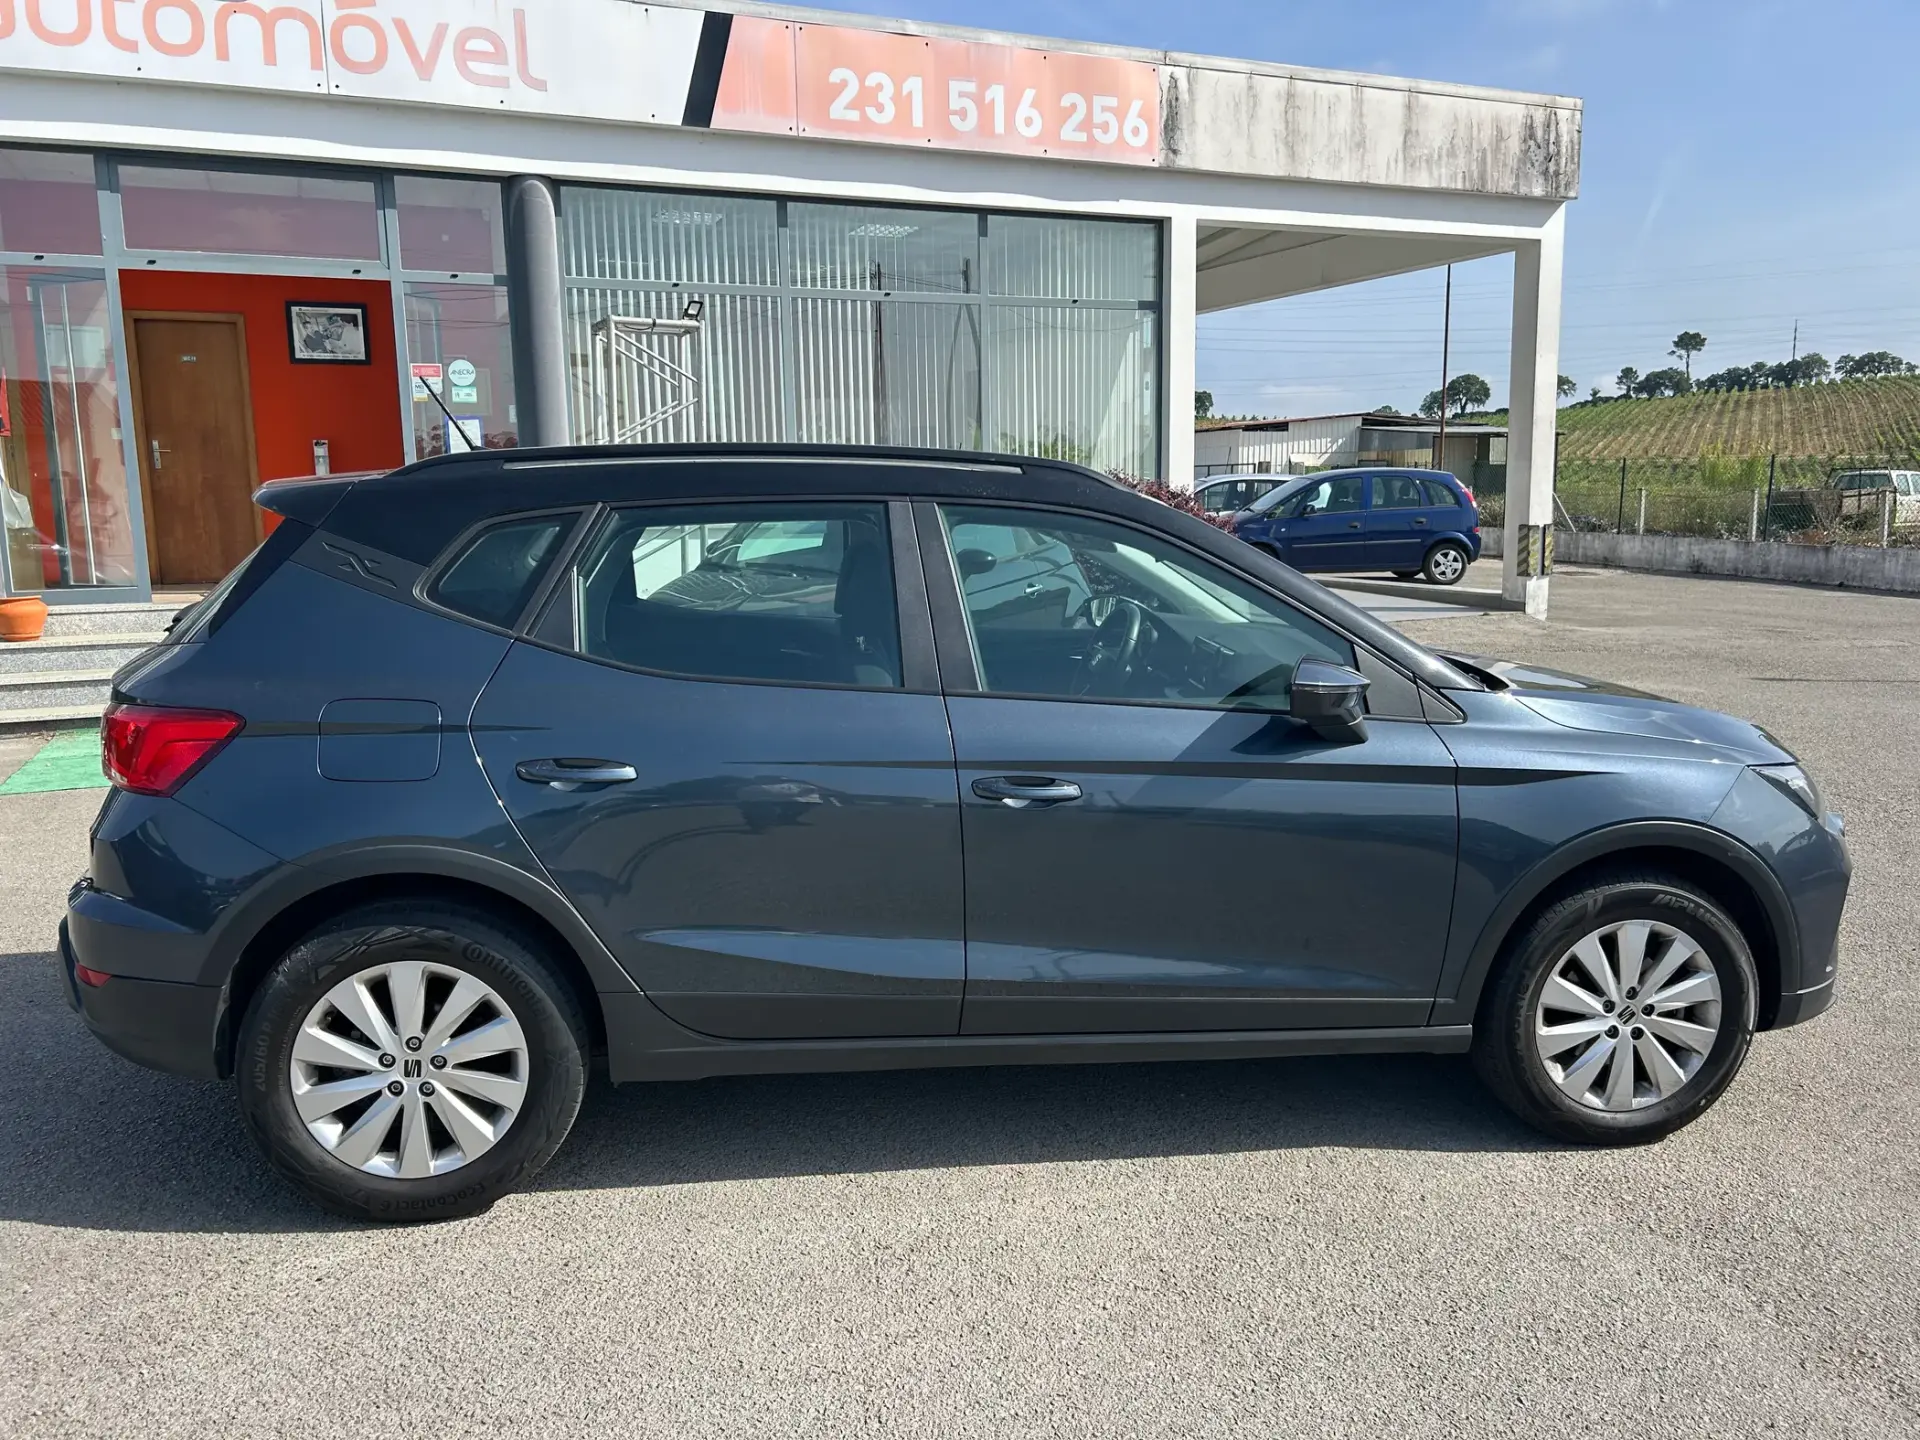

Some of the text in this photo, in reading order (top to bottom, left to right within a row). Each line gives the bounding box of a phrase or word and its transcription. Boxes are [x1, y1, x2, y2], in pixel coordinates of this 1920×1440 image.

[0, 0, 547, 92] utomóvel
[828, 67, 1148, 147] 231 516 256
